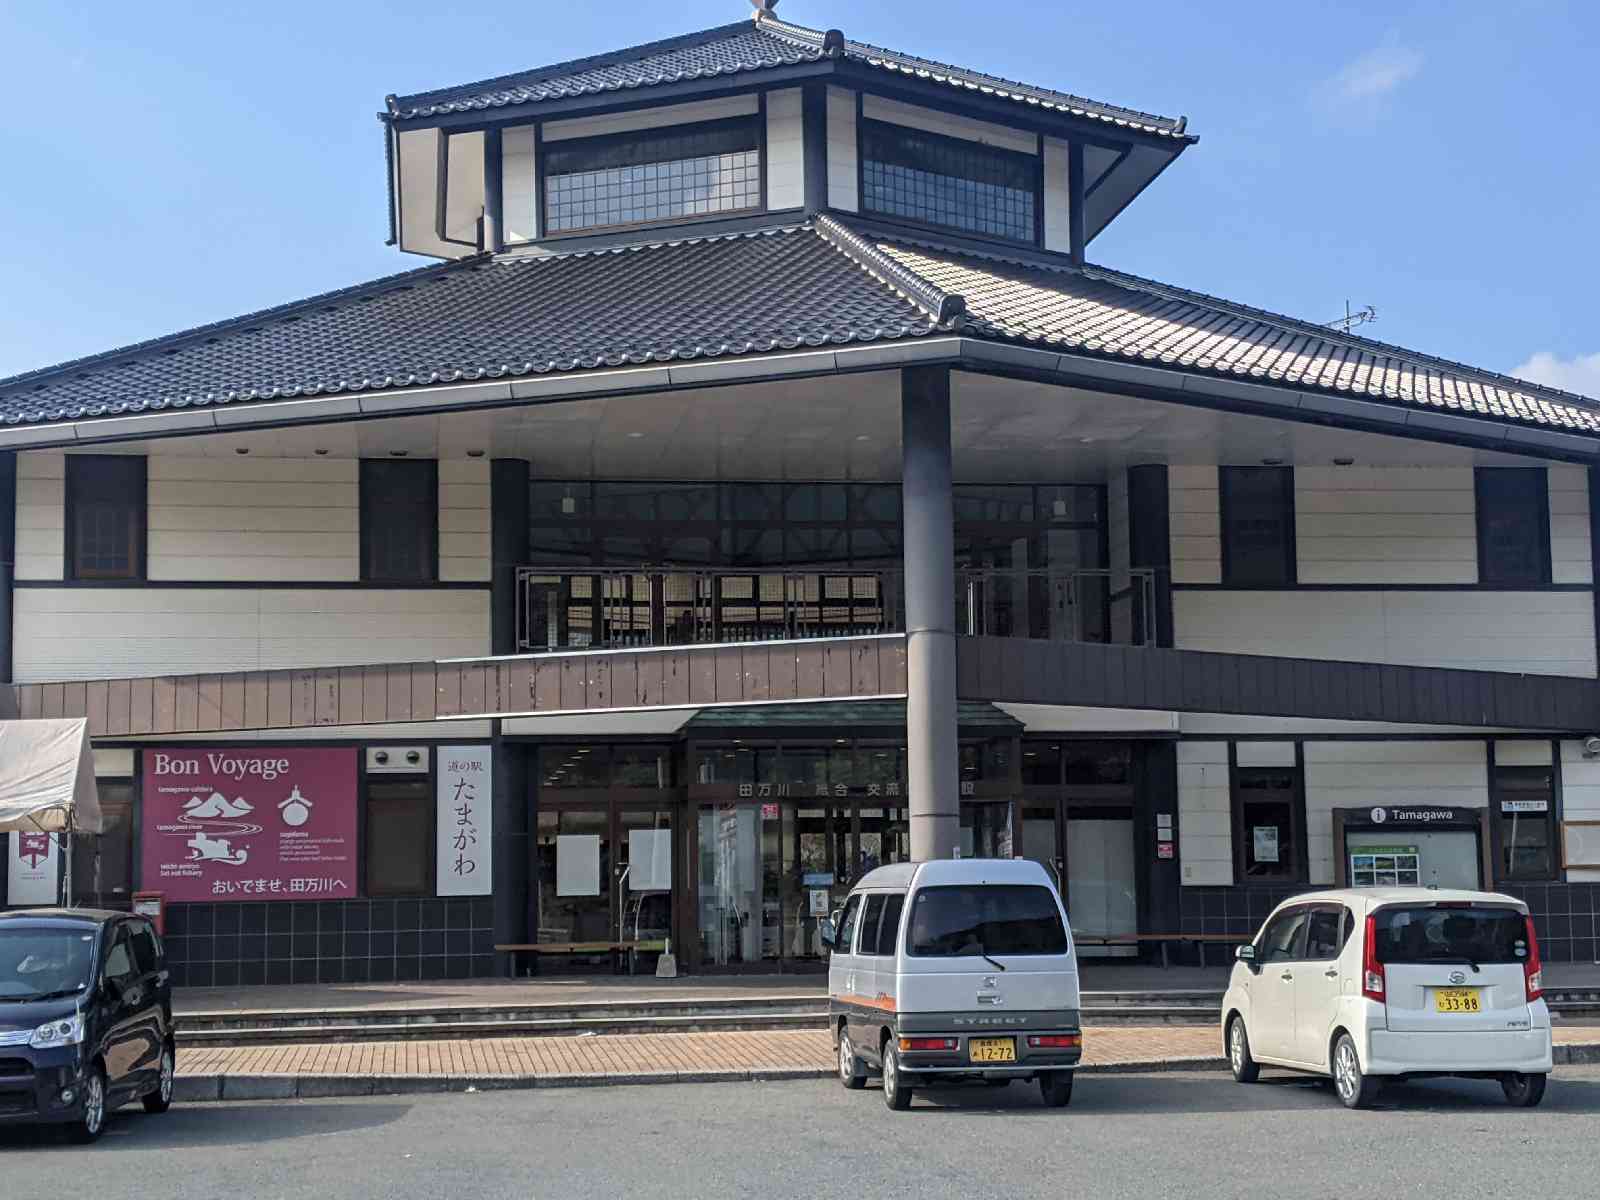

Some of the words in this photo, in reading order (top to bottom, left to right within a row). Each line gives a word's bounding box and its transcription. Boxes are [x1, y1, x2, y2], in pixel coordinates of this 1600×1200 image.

[154, 754, 200, 775] Bon
[207, 753, 289, 780] Voyage
[448, 761, 483, 772] 道の駅
[739, 783, 790, 797] 田万川
[1392, 809, 1453, 821] Tamagawa
[453, 777, 476, 876] たまがわ
[212, 878, 347, 893] おいでませ、田万川へ
[1446, 998, 1478, 1010] 33-88
[981, 1047, 1014, 1060] 12-72
